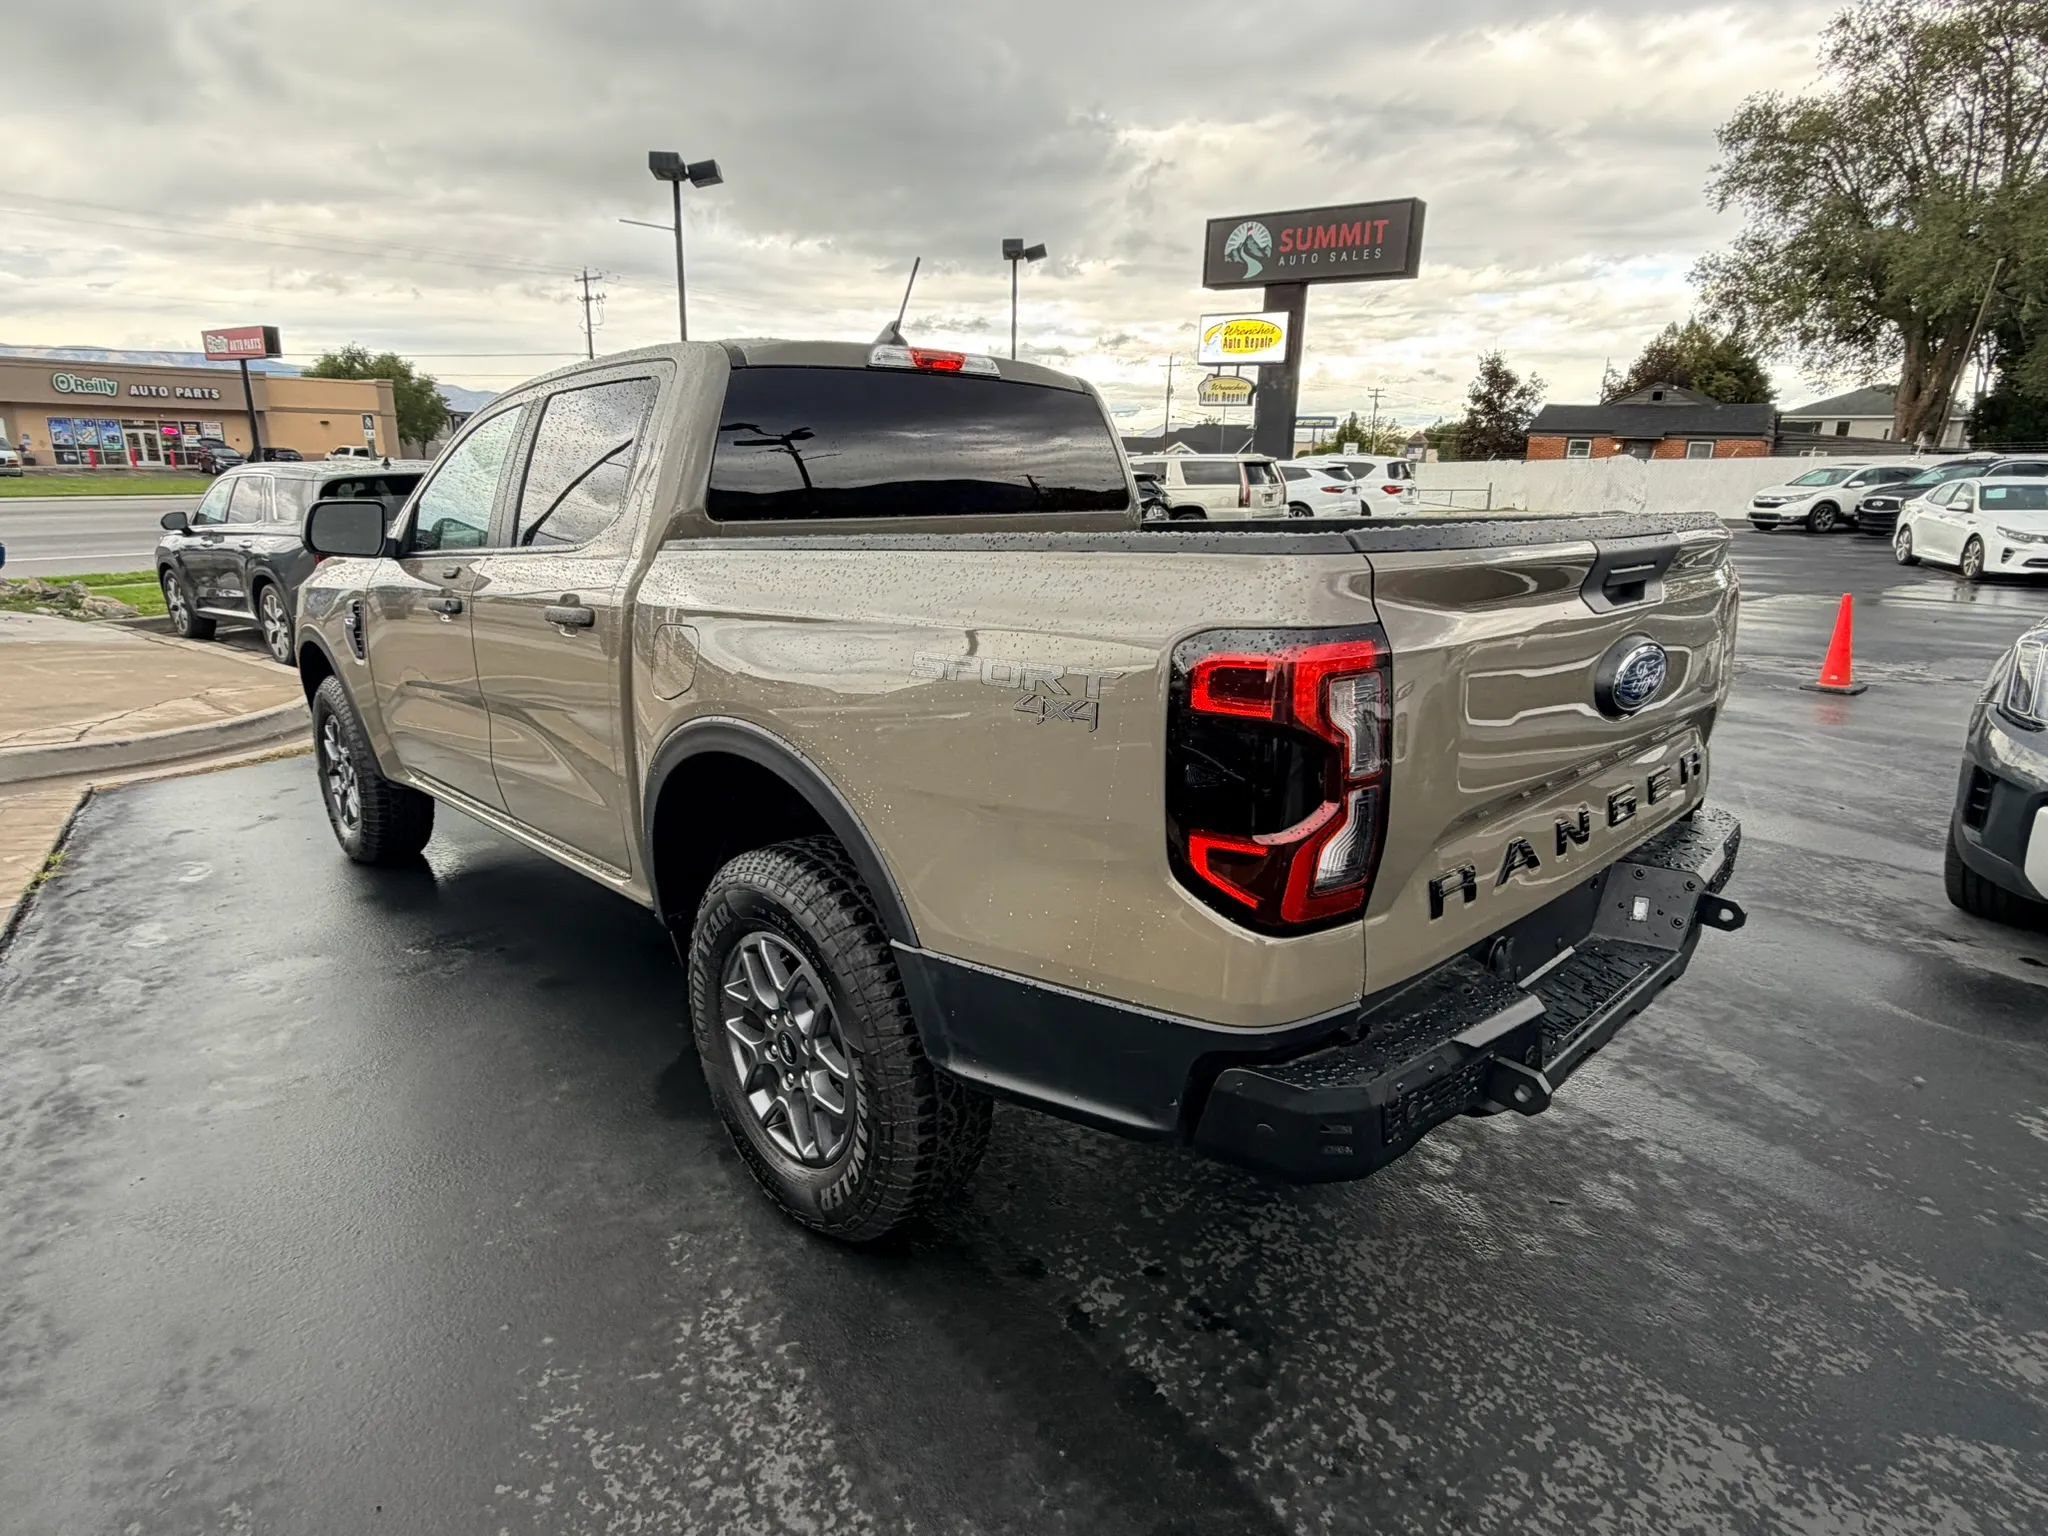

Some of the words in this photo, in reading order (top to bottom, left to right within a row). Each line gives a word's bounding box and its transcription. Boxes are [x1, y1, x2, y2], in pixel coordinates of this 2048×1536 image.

[1279, 219, 1390, 253] SUMMIT
[1278, 252, 1319, 266] AUTO
[1329, 247, 1382, 262] SALES
[1223, 336, 1243, 349] Auto
[1244, 335, 1275, 349] Repair
[53, 373, 118, 396] O'Reilly
[129, 384, 169, 397] AUTO
[175, 387, 221, 400] PARTS
[1202, 391, 1219, 402] Auto
[1221, 391, 1247, 402] Repair
[910, 651, 1127, 699] SPORT
[1429, 749, 1701, 924] RANGER
